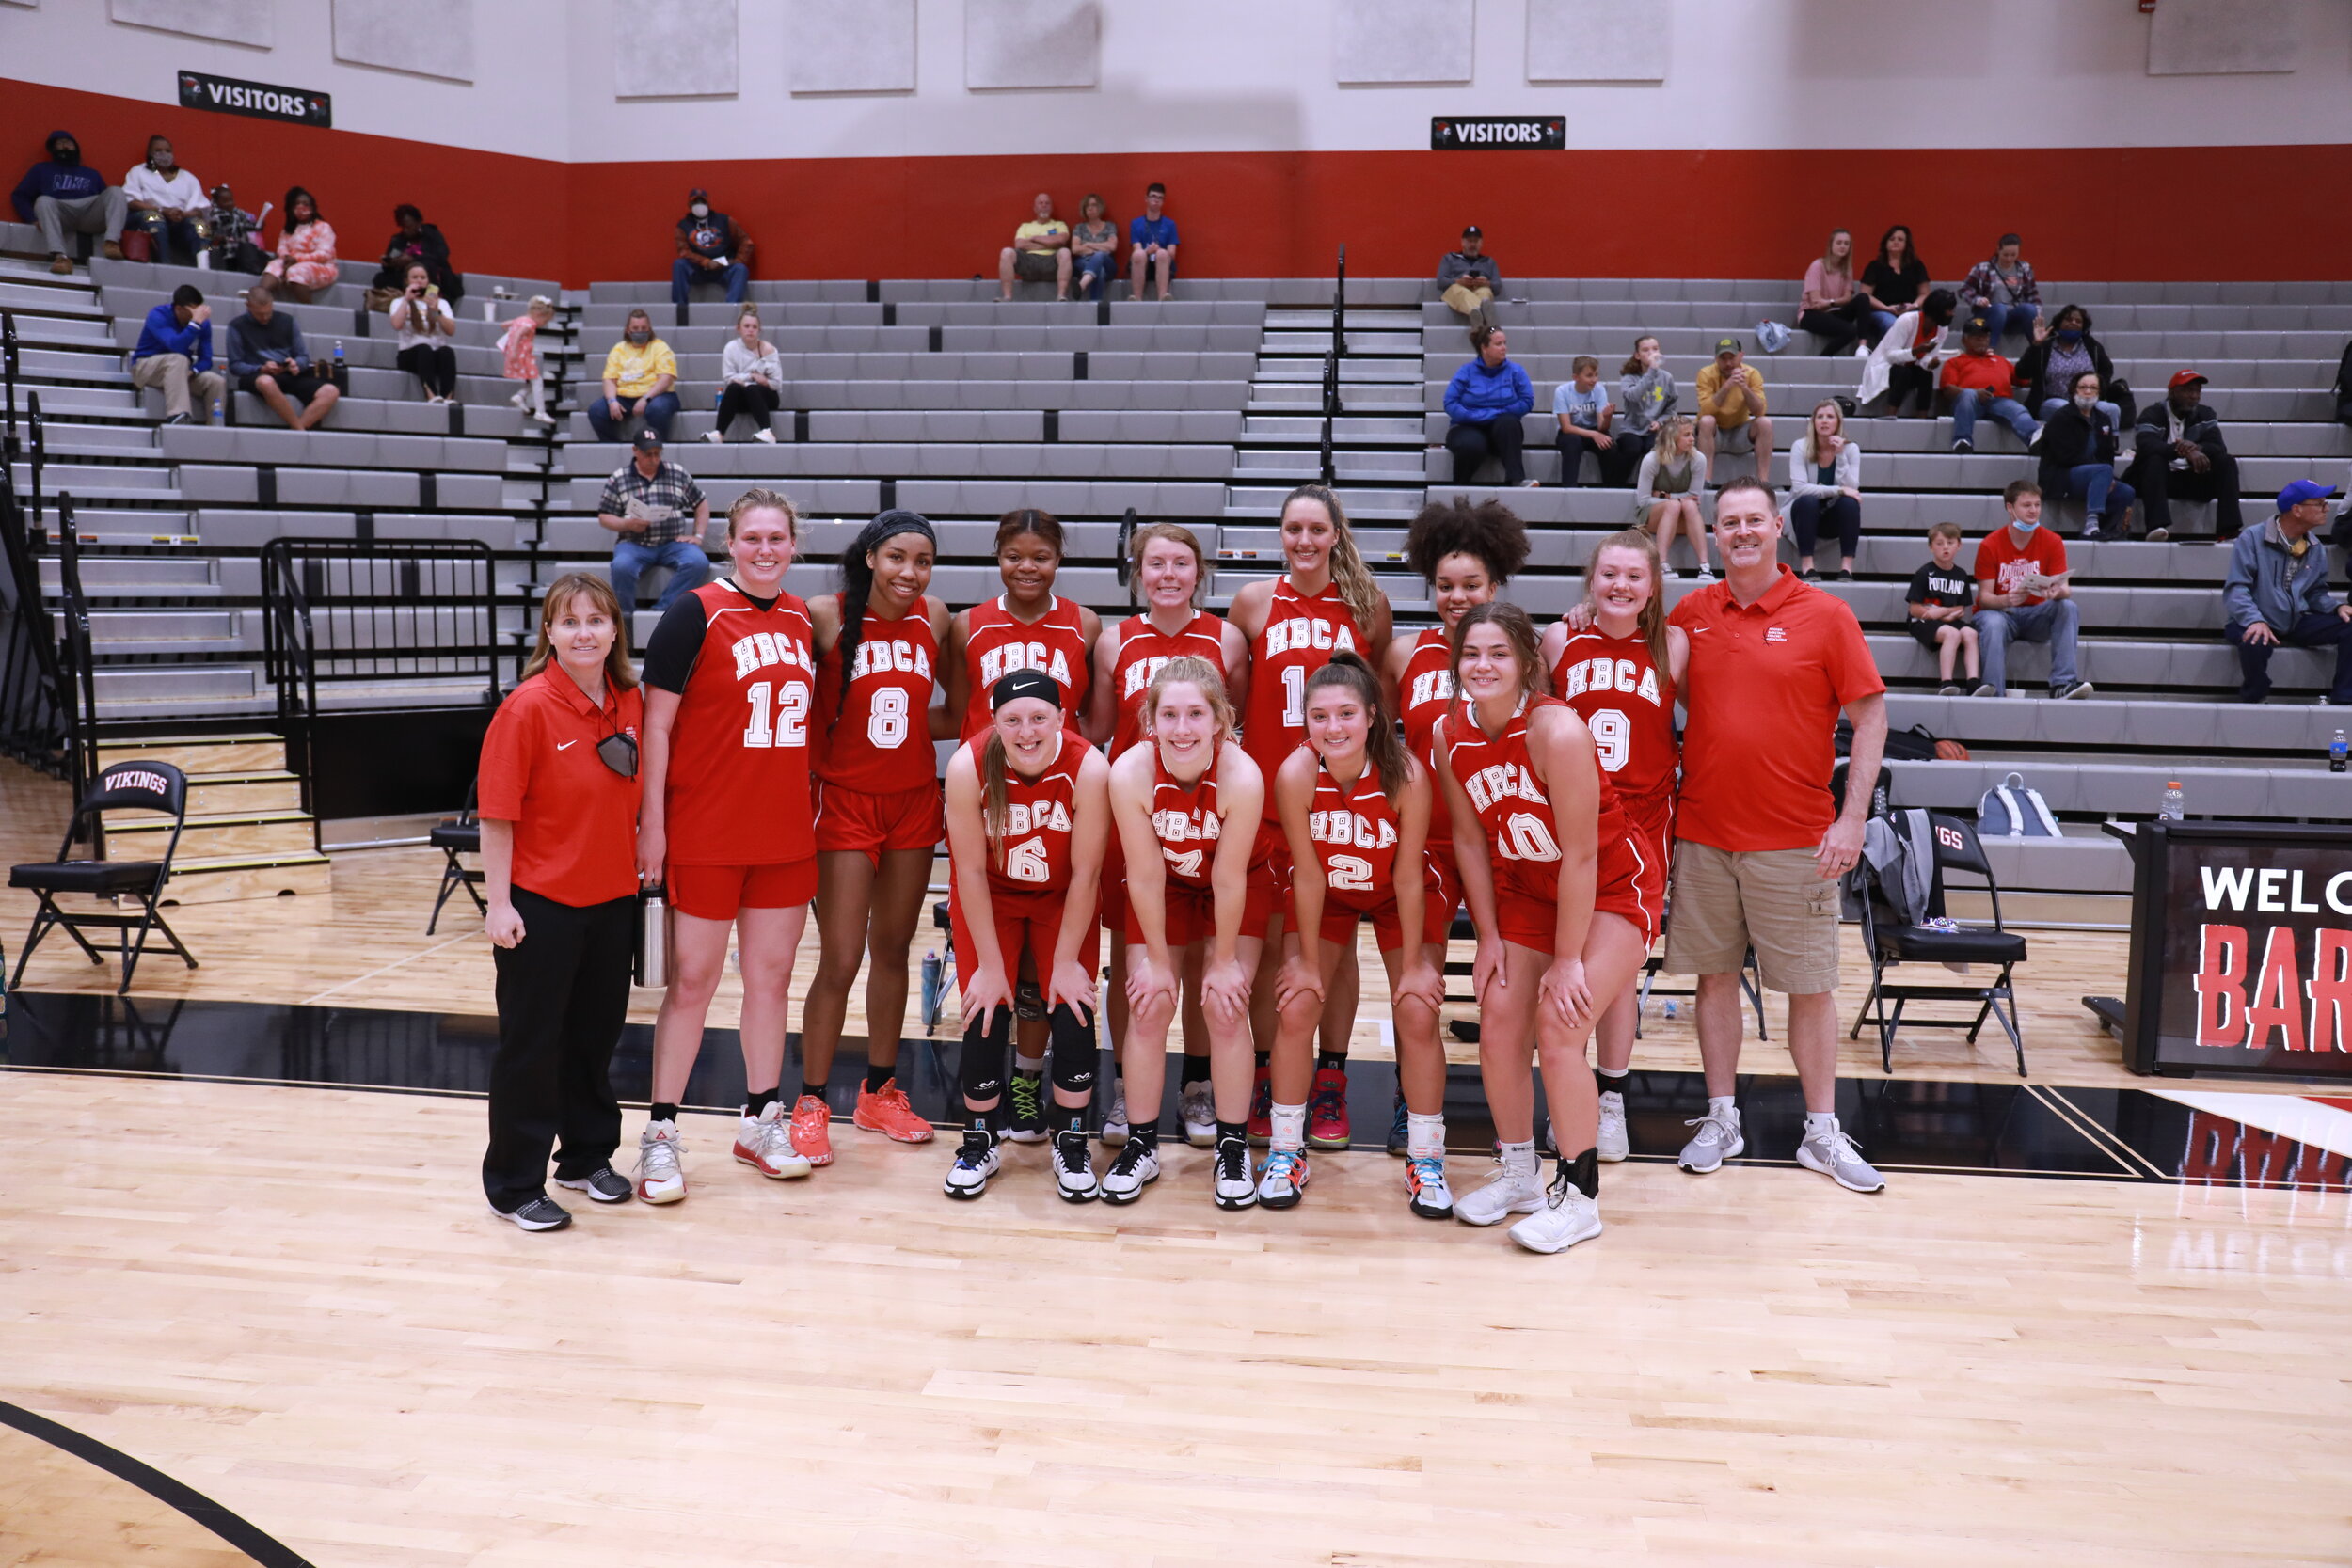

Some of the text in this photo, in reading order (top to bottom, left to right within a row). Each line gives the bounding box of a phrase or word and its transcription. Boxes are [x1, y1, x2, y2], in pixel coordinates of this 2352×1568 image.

[207, 83, 306, 117] VISITORS
[1455, 122, 1542, 143] VISITORS
[53, 174, 91, 191] NIKE
[1928, 576, 1965, 595] POTLAND
[731, 632, 815, 681] HBCA
[1265, 617, 1356, 660] HBCA
[850, 640, 932, 684] HBCA
[980, 641, 1072, 689] HBCA
[1566, 657, 1661, 708] HBCA
[743, 680, 809, 748] 12
[867, 687, 909, 749] 8
[1588, 708, 1631, 772] 9
[104, 770, 168, 795] VIKINGS
[1465, 761, 1549, 814] HBCA
[1309, 810, 1398, 849] HBCA
[1007, 835, 1050, 883] 6
[1162, 846, 1203, 878] 7
[1327, 853, 1374, 891] 2
[2193, 923, 2352, 1053] BAR
